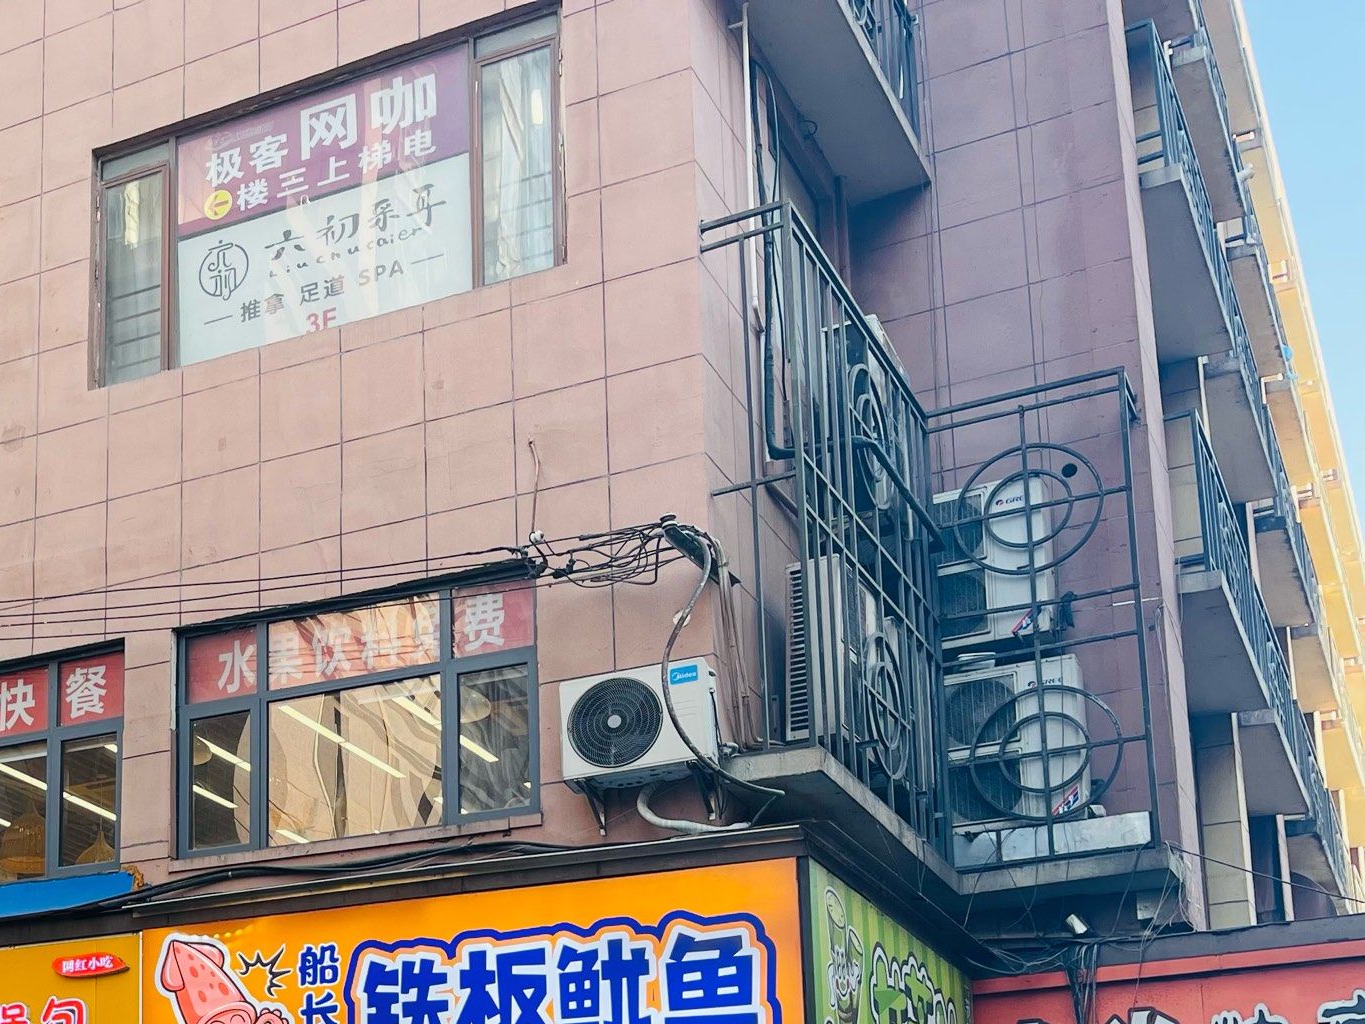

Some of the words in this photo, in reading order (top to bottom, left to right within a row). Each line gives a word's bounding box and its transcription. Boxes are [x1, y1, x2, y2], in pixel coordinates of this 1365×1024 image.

[204, 73, 436, 187] 极客网咖
[239, 293, 285, 323] 推拿
[299, 273, 345, 304] 足道
[358, 260, 404, 287] SPA
[306, 308, 337, 334] 3F
[218, 592, 506, 694] 水果饮料免费
[61, 955, 114, 974] 网红小吃
